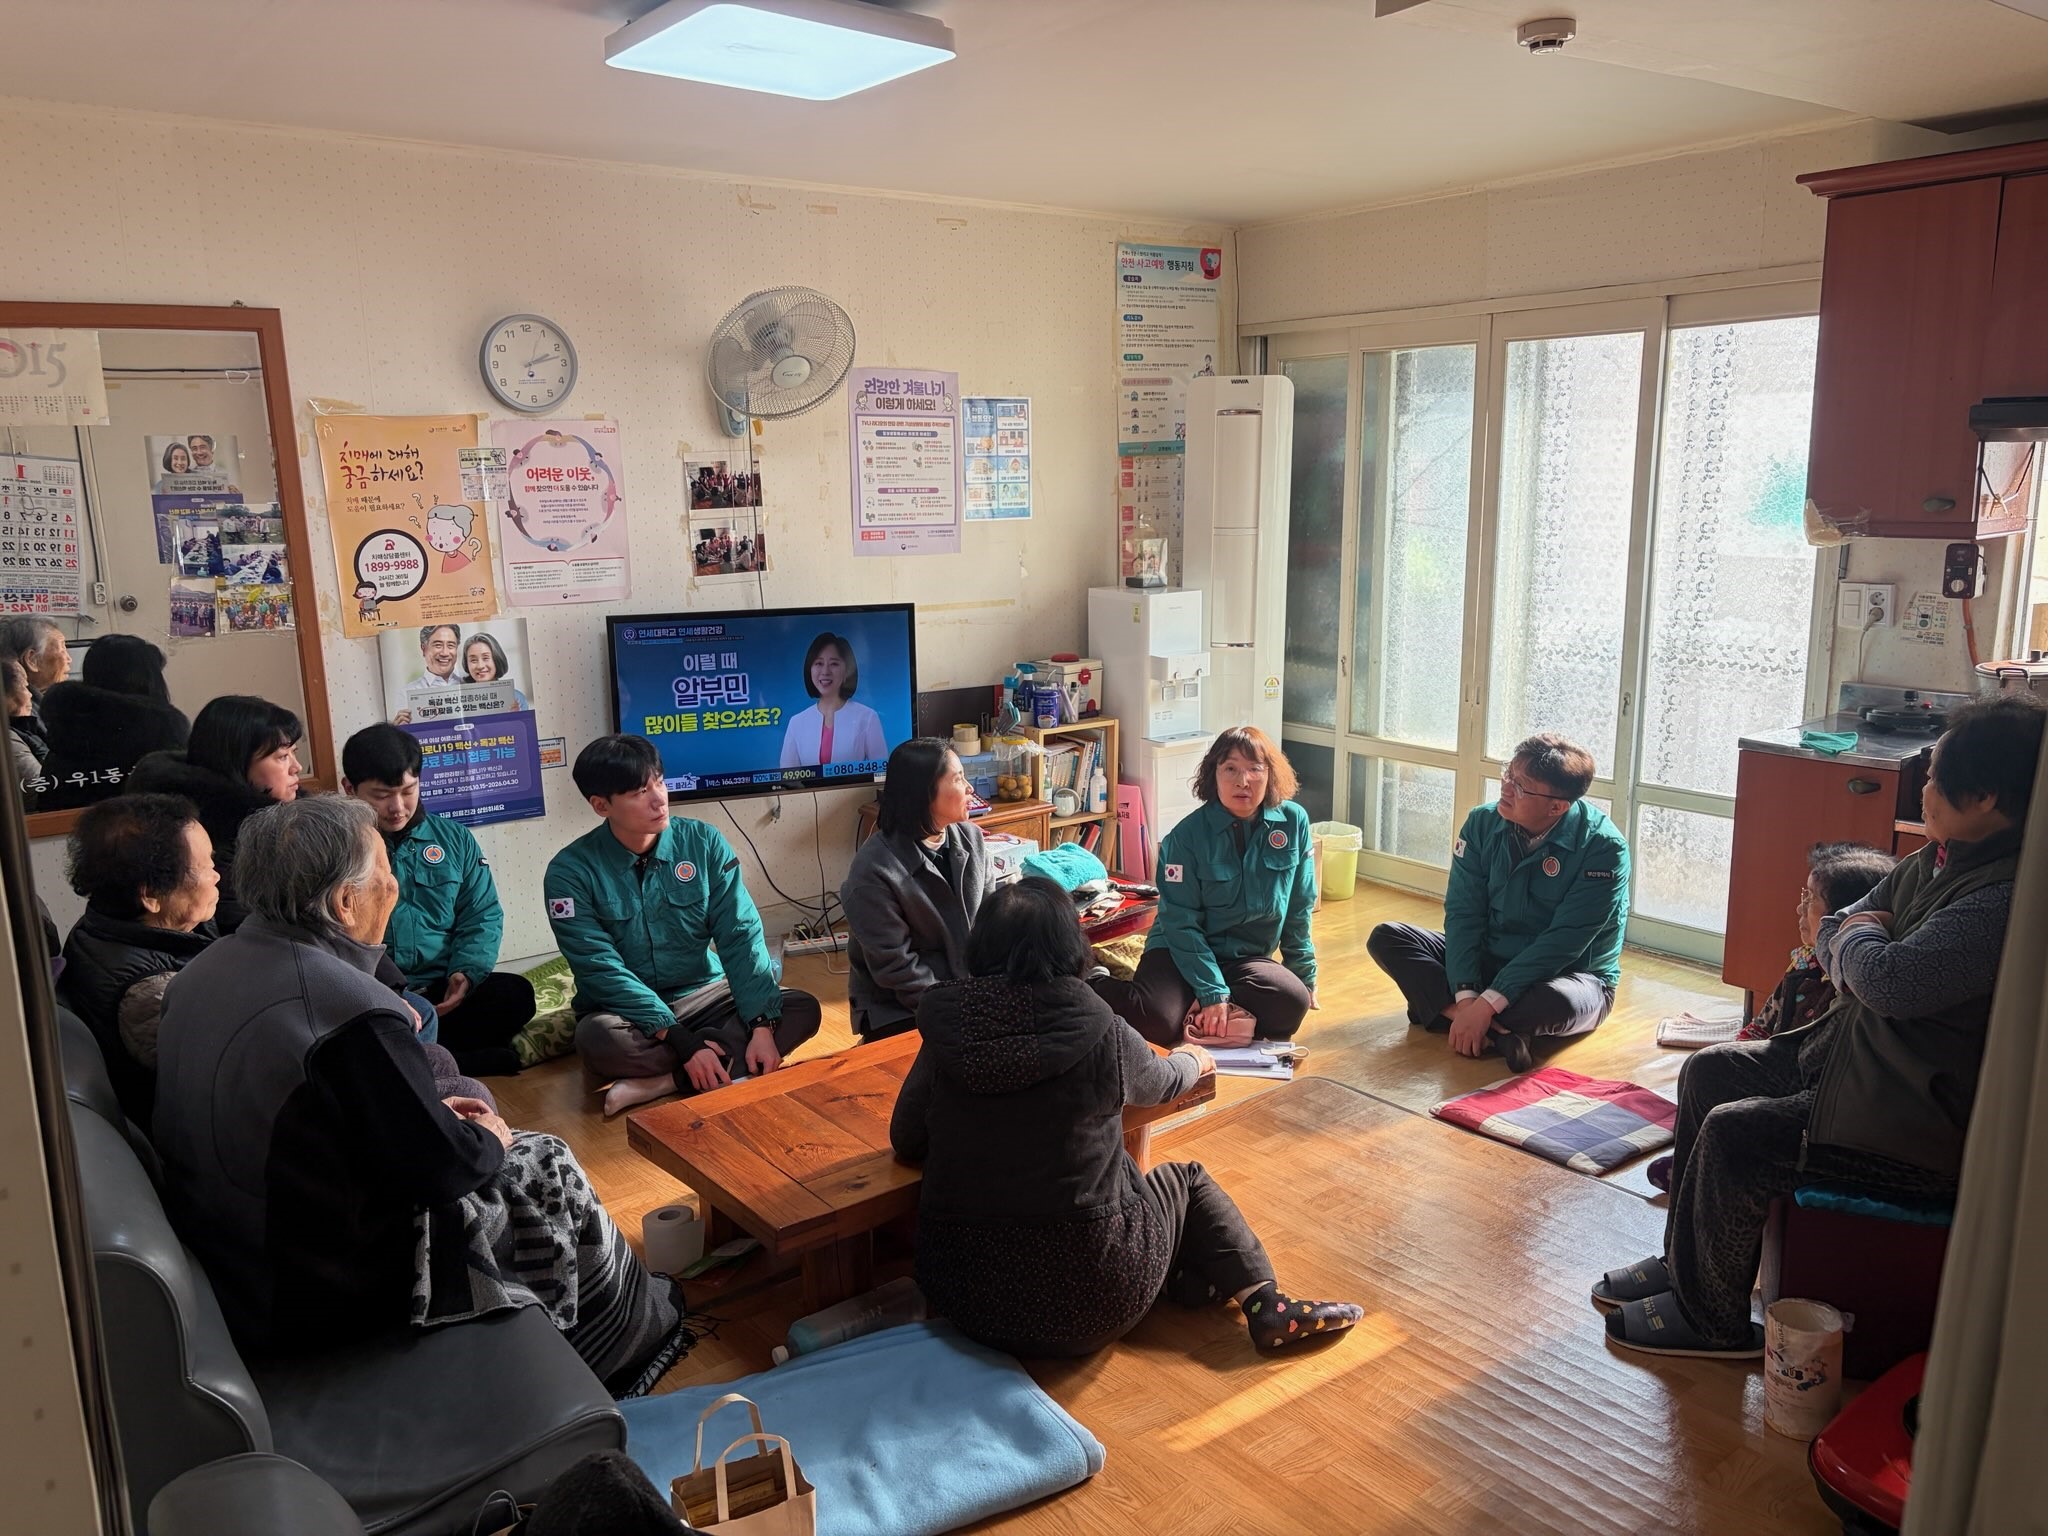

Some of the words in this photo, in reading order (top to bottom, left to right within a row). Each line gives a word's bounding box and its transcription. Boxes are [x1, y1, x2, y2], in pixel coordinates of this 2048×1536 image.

[1121, 258, 1135, 268] 안전
[1137, 259, 1165, 270] 사고예방
[1167, 260, 1194, 271] 행동지침
[505, 330, 515, 338] 11
[520, 324, 531, 332] 12
[541, 330, 546, 338] 1
[561, 359, 567, 367] 3
[500, 378, 507, 386] 8
[865, 377, 900, 395] 건강한
[903, 379, 945, 397] 겨울나기
[531, 395, 537, 403] 6
[547, 389, 553, 397] 5
[876, 397, 904, 411] 이렇게
[906, 398, 936, 411] 하세요!
[339, 441, 382, 463] 치매에
[387, 444, 419, 460] 대해
[340, 461, 424, 489] 궁금하세요?
[526, 467, 564, 482] 어려운
[567, 467, 595, 481] 이웃,
[369, 503, 405, 511] 필요하세요?
[365, 560, 419, 573] 1899-9988
[638, 628, 677, 638] 연세대학교
[678, 626, 723, 636] 연세생활건강
[683, 653, 716, 671] 이럴
[721, 652, 738, 669] 때
[672, 673, 749, 709] 알부민
[428, 698, 443, 706] 독감
[444, 696, 458, 704] 백신
[460, 693, 488, 703] 접종하실
[422, 708, 438, 717] 함께
[438, 707, 453, 715] 맞을
[479, 701, 505, 710] 백신은?
[645, 713, 698, 735] 많이들
[702, 707, 782, 731] 찾으셨죠?
[440, 734, 462, 742] 어르신은
[455, 741, 472, 750] 백신
[480, 738, 496, 747] 독감
[498, 736, 515, 744] 백신
[443, 753, 465, 766] 동시
[468, 749, 491, 763] 접종
[493, 747, 516, 759] 가능
[20, 775, 59, 793] (증)
[65, 767, 124, 788] 우1동
[753, 774, 768, 782] 70%
